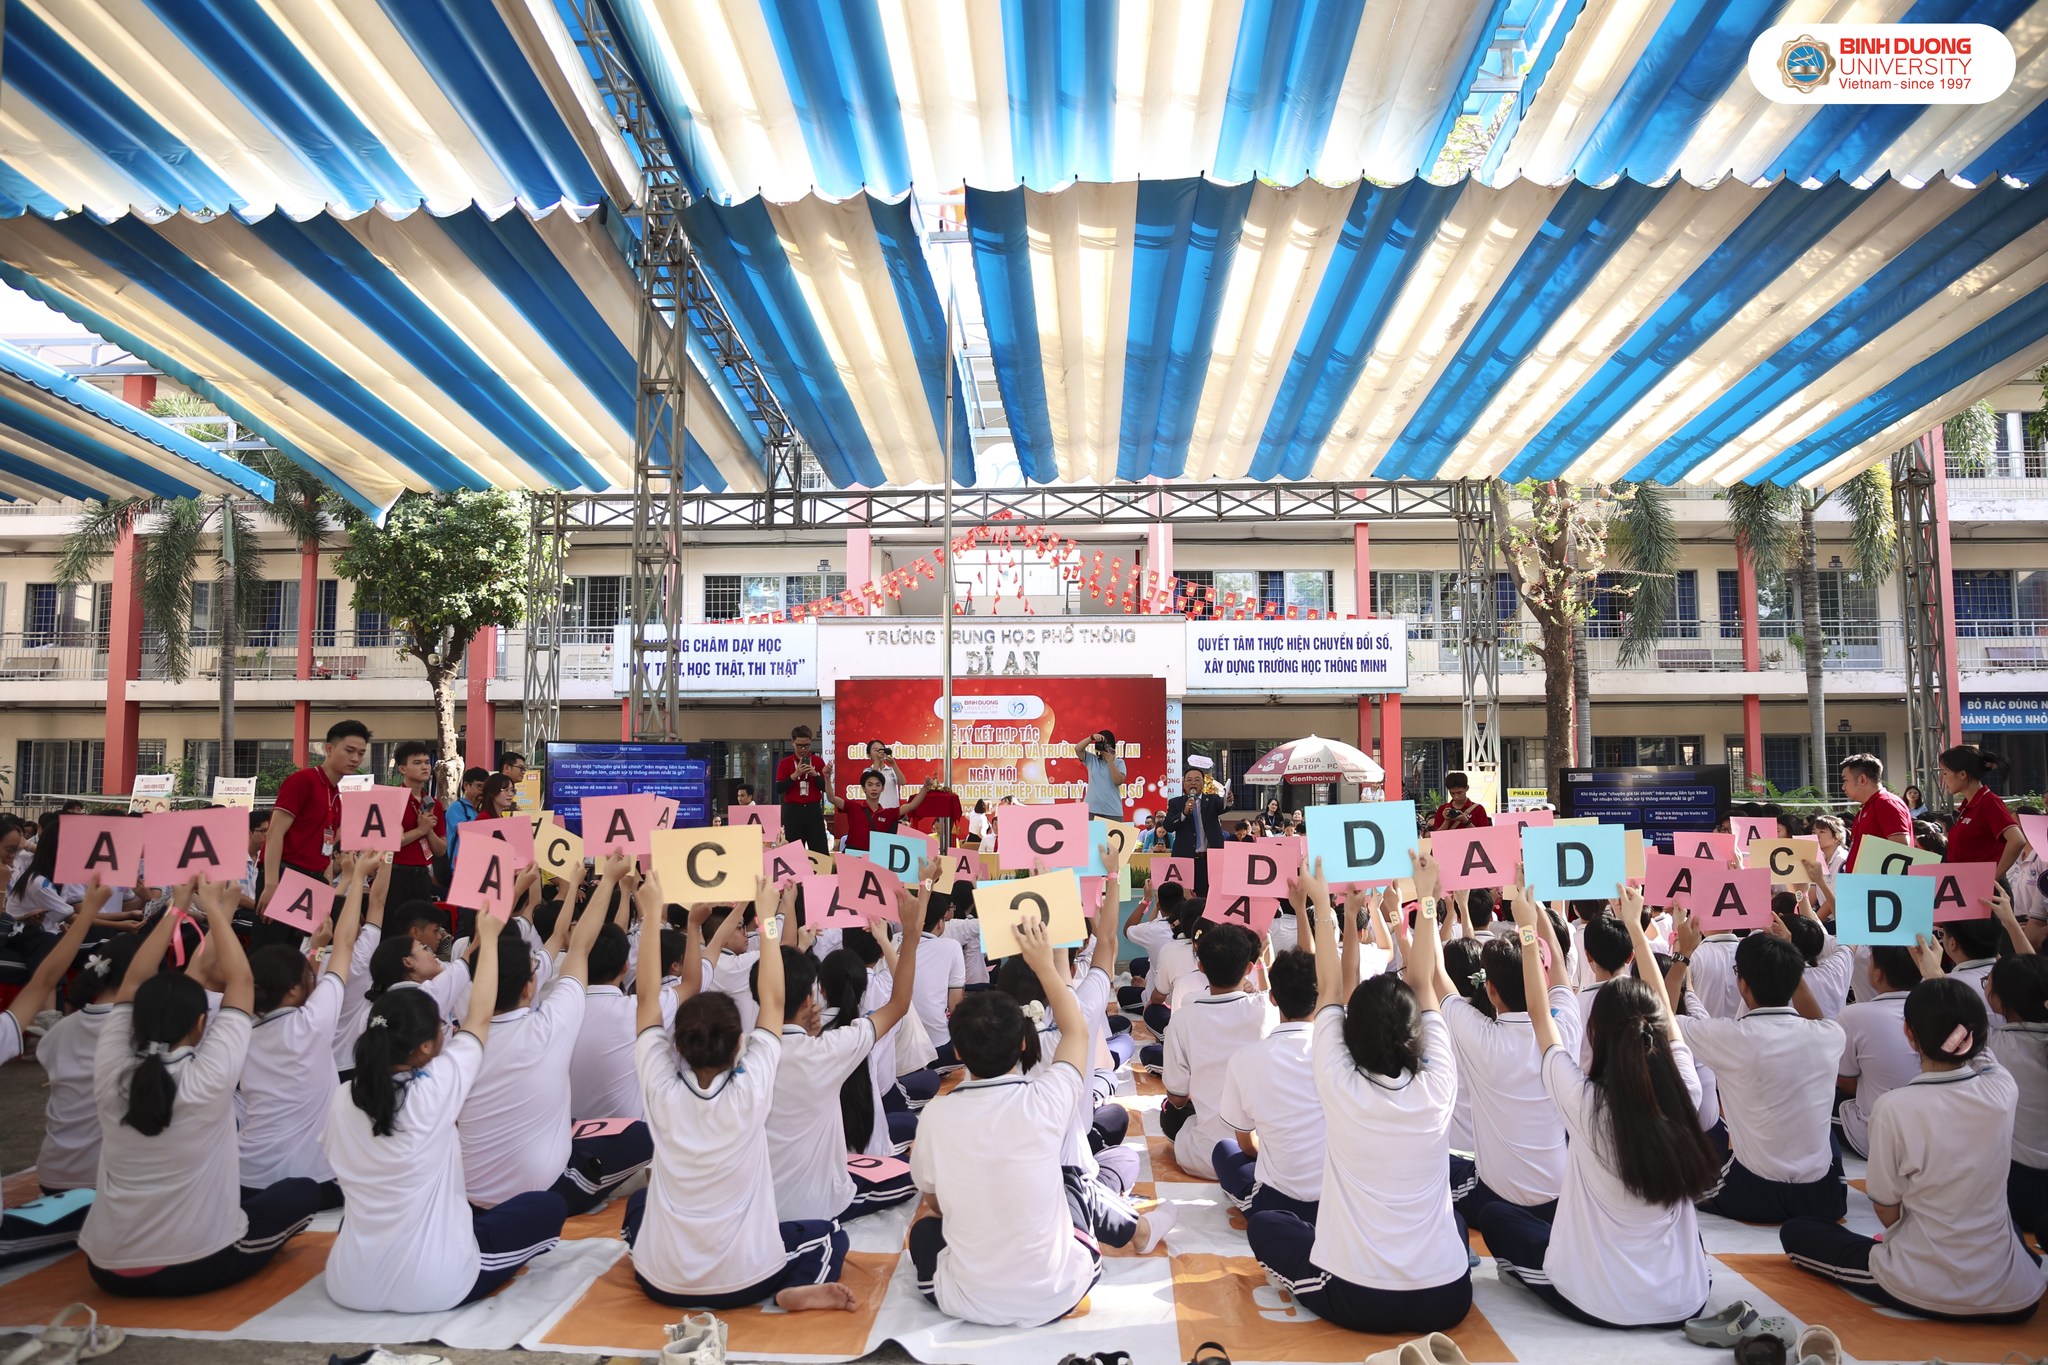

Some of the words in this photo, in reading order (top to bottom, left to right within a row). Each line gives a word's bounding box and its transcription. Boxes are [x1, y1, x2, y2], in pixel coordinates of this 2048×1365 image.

[693, 636, 728, 652] CHÂM
[732, 638, 754, 655] DẠY
[758, 638, 782, 655] HỌC
[865, 625, 936, 645] TRƯỜNG
[951, 629, 995, 645] RUNG
[1001, 629, 1036, 648] HỌC
[1042, 623, 1075, 644] PHỔ
[1079, 625, 1136, 644] THÔNG
[1198, 633, 1230, 652] QUYẾT
[1233, 635, 1255, 651] TÂM
[1258, 636, 1284, 653] THỰC
[1287, 634, 1310, 653] HIỆN
[1313, 631, 1353, 650] CHUYỂN
[1356, 631, 1373, 650] ĐỔI
[687, 662, 710, 678] HỌC
[715, 659, 745, 678] THẬT,
[748, 662, 766, 676] THI
[966, 645, 994, 675] DĨ
[1002, 651, 1041, 675] AN
[1204, 658, 1224, 674] XÂY
[1227, 659, 1255, 676] DỰNG
[1258, 656, 1298, 673] TRƯỜNG
[1301, 659, 1321, 676] HỌC
[1324, 657, 1357, 673] THÔNG
[1360, 659, 1387, 673] MINH
[1967, 698, 1982, 710] BỎ
[1984, 698, 2006, 710] RÁC
[2008, 698, 2038, 710] ĐÚNG
[1961, 713, 1990, 724] HÀNH
[1992, 713, 2022, 727] ĐỘNG
[2025, 711, 2048, 724] NHỎ
[959, 724, 973, 742] KÝ
[975, 724, 994, 742] KẾT
[996, 726, 1018, 743] HỢP
[1019, 724, 1040, 742] TÁC
[848, 743, 870, 759] GIỮ
[917, 743, 937, 762] ĐẠI
[960, 741, 986, 759] BÌNH
[988, 742, 1023, 759] DƯƠNG
[1024, 740, 1040, 758] VÀ
[1041, 740, 1077, 758] TRƯỜN
[1125, 743, 1141, 758] AN
[969, 765, 996, 782] NGÀY
[999, 765, 1017, 783] HỘI
[1290, 775, 1336, 783] dienthoaivui
[846, 784, 867, 800] STE
[995, 782, 1032, 800] NGHIỆP
[1034, 784, 1068, 798] TRONG
[361, 803, 387, 838] A
[605, 808, 635, 843] A
[656, 806, 670, 829] A
[747, 813, 766, 834] A
[176, 826, 221, 869] A
[1027, 818, 1064, 855] C
[1343, 820, 1385, 868] D
[1746, 825, 1762, 846] A
[84, 831, 119, 871] A
[547, 838, 570, 867] C
[686, 841, 727, 888] C
[888, 844, 911, 874] D
[955, 855, 971, 874] A
[1460, 840, 1497, 876] A
[1695, 842, 1715, 860] A
[1769, 847, 1795, 876] C
[478, 855, 501, 900] A
[773, 857, 796, 883] A
[1164, 863, 1183, 882] A
[1247, 854, 1278, 885] D
[1556, 842, 1594, 888] D
[858, 870, 887, 905] A
[1666, 868, 1692, 898] A
[1934, 875, 1967, 910] A
[286, 888, 314, 921] A
[1224, 896, 1250, 924] A
[1426, 900, 1435, 915] 96
[1712, 883, 1748, 917] A
[1867, 889, 1903, 933] D
[767, 919, 777, 935] 94
[1523, 929, 1534, 942] 97
